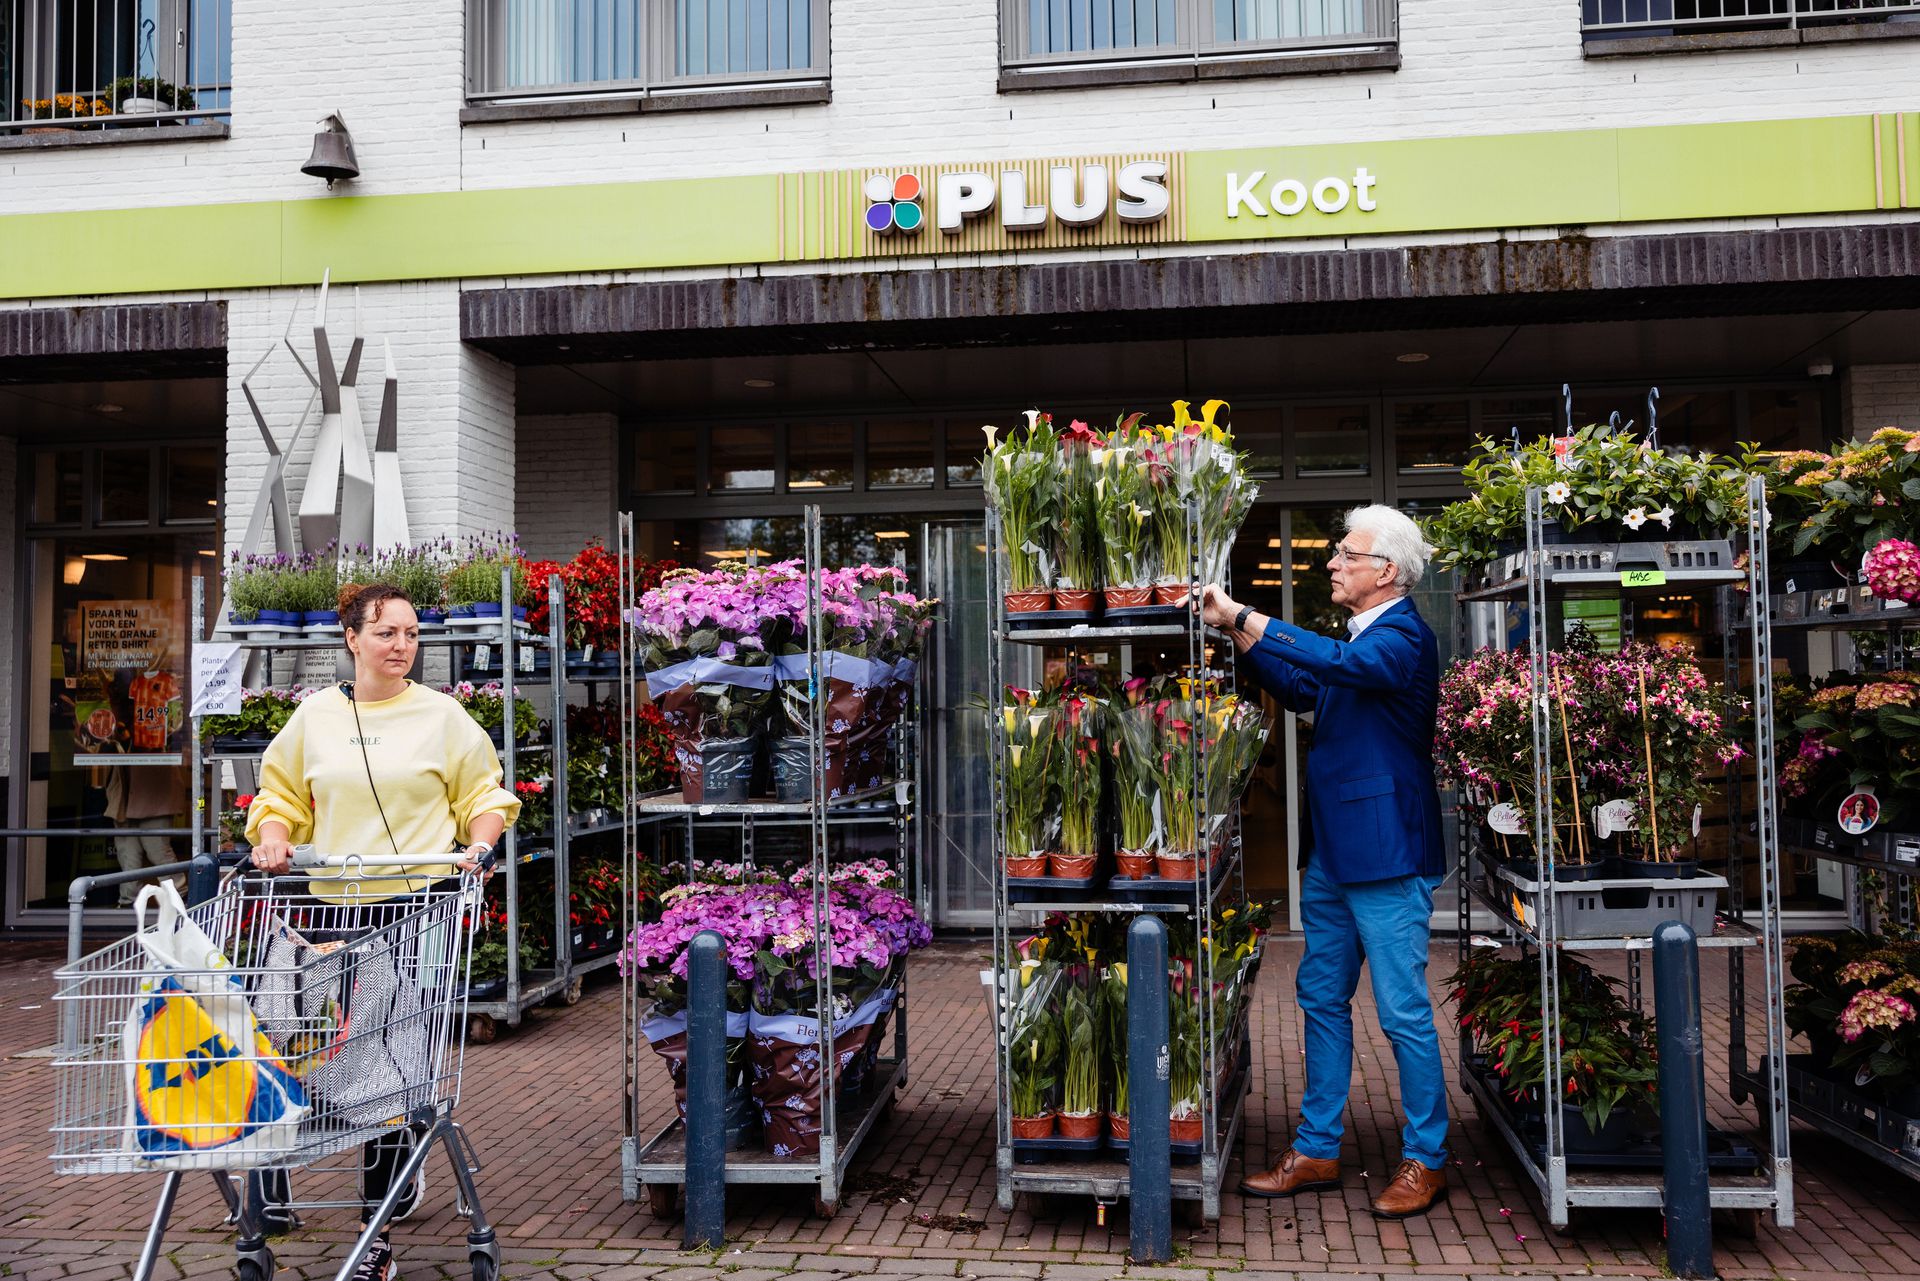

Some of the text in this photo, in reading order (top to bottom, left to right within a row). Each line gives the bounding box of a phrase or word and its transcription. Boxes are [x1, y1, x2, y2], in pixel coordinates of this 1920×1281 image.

[938, 160, 1377, 233] PLUS Koot
[88, 609, 138, 618] SPAAR NU
[88, 620, 136, 628] VOOR EEN
[88, 629, 157, 639] UNIEK ORANJE
[88, 640, 149, 649] RETRO SHIRT
[87, 652, 104, 660] MET
[129, 651, 153, 660] NAAM
[87, 660, 149, 669] EN RUGNUMMER
[215, 667, 230, 675] tuk
[349, 737, 381, 745] SMILE
